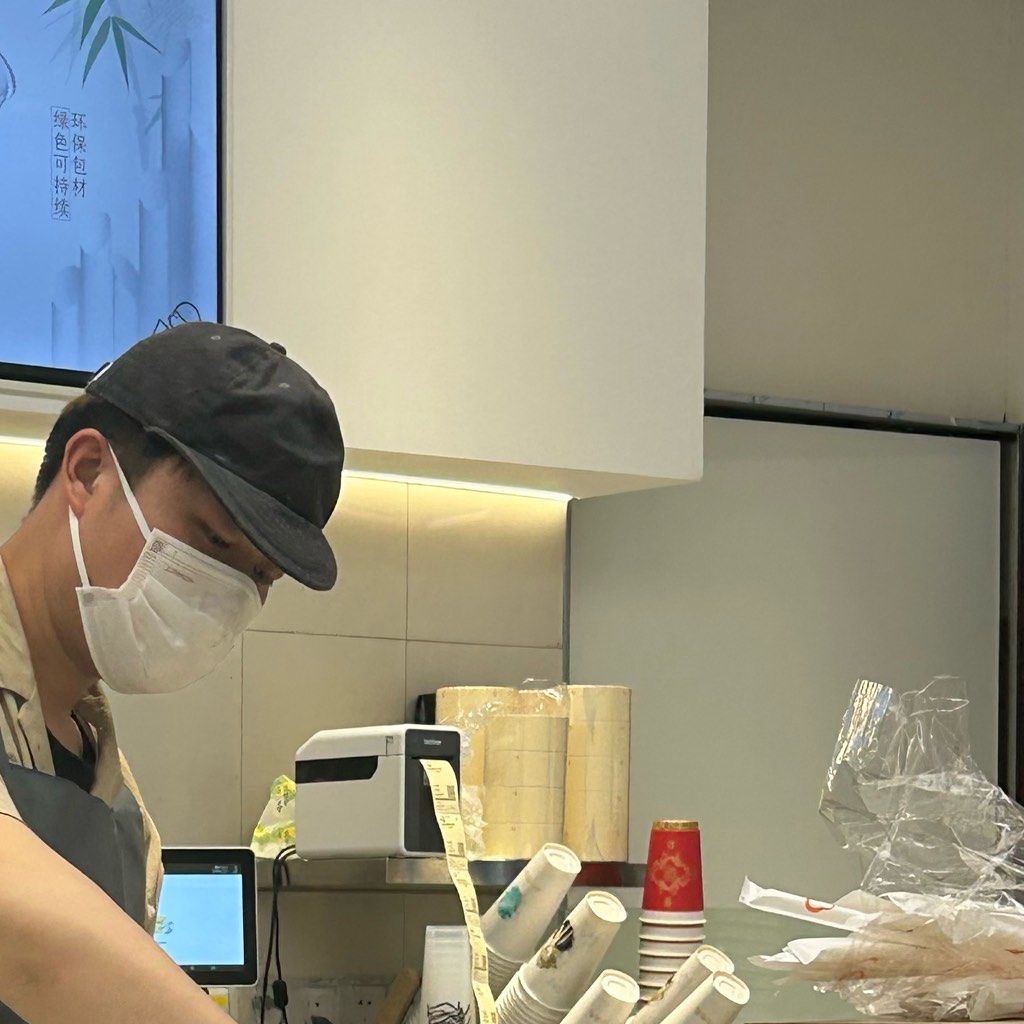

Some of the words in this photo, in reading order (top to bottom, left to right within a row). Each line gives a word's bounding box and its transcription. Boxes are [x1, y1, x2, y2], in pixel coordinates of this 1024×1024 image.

[53, 110, 70, 219] 绿色可持续
[71, 112, 87, 198] 环保包材
